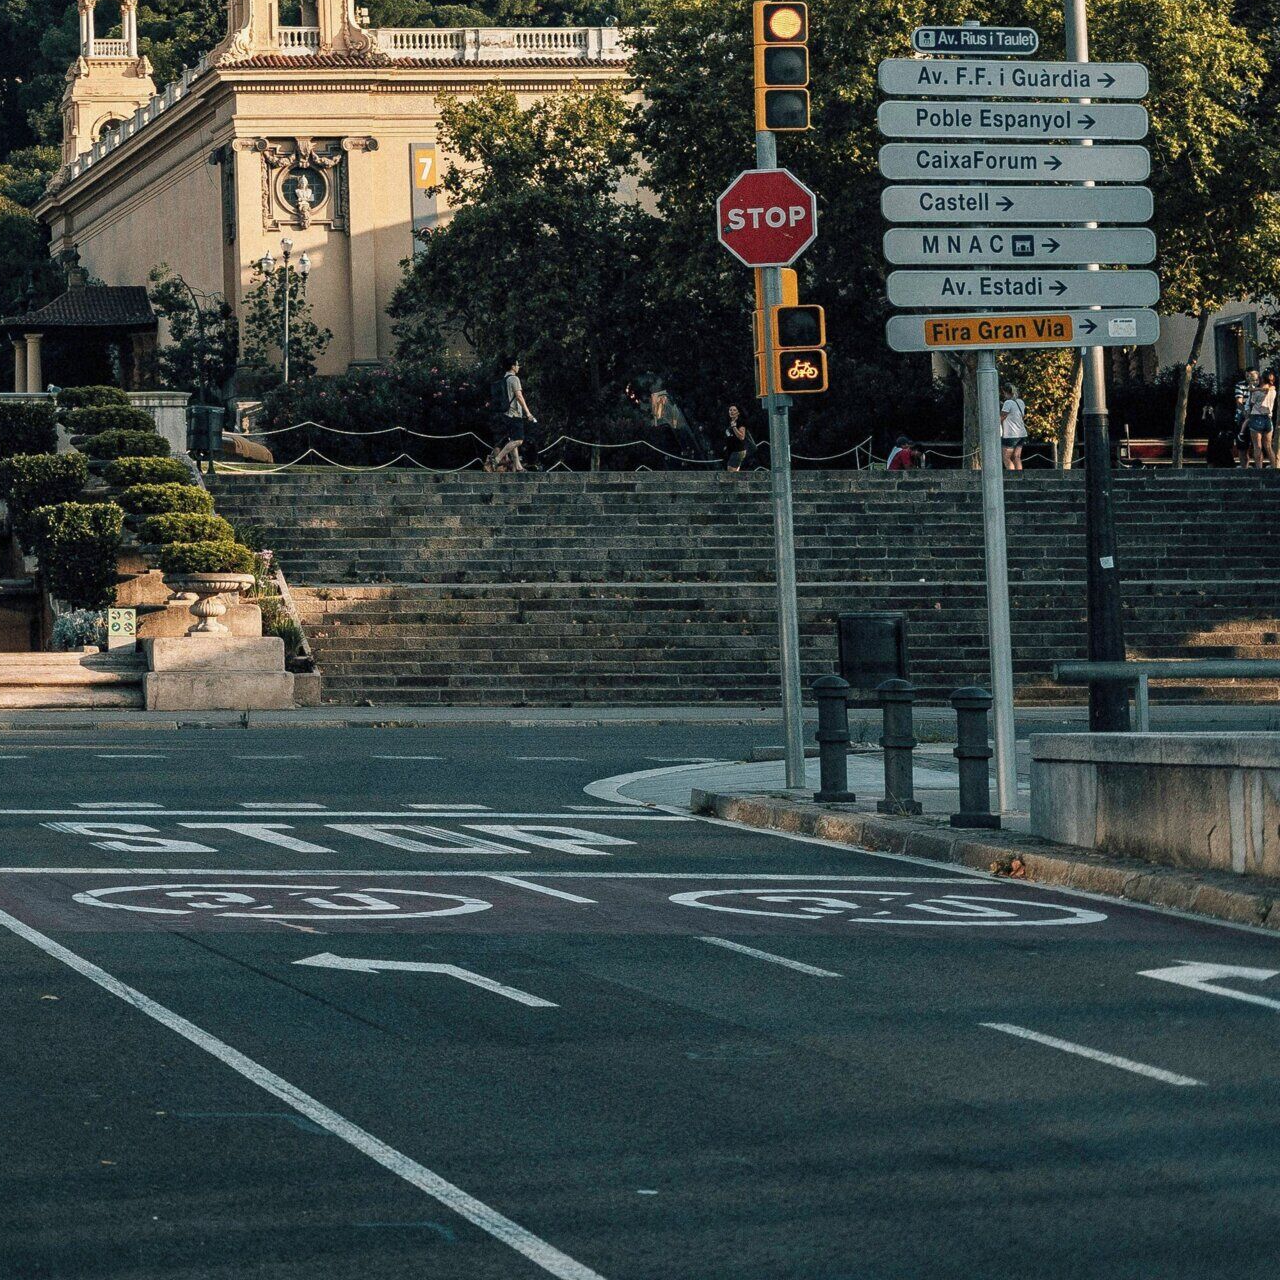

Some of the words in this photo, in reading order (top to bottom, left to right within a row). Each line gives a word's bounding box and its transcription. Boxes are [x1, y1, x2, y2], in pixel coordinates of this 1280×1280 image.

[938, 31, 957, 45] Av.
[961, 32, 987, 45] Rius
[990, 32, 993, 45] i
[997, 32, 1034, 45] Taulet
[918, 67, 948, 85] Av.
[956, 67, 992, 86] F.F.
[1000, 68, 1004, 86] i
[1012, 68, 1090, 88] Guàrdia
[917, 108, 972, 127] Poble
[980, 109, 1071, 132] Espanyol
[418, 157, 433, 181] 7
[916, 150, 1037, 169] CaixaForum
[919, 192, 989, 211] Castell
[728, 206, 806, 230] STOP
[941, 277, 972, 296] Av.
[980, 277, 1043, 295] Estadi
[933, 323, 971, 342] Fira
[978, 321, 1026, 339] Gran
[1032, 319, 1064, 337] Via
[39, 822, 638, 856] STOP
